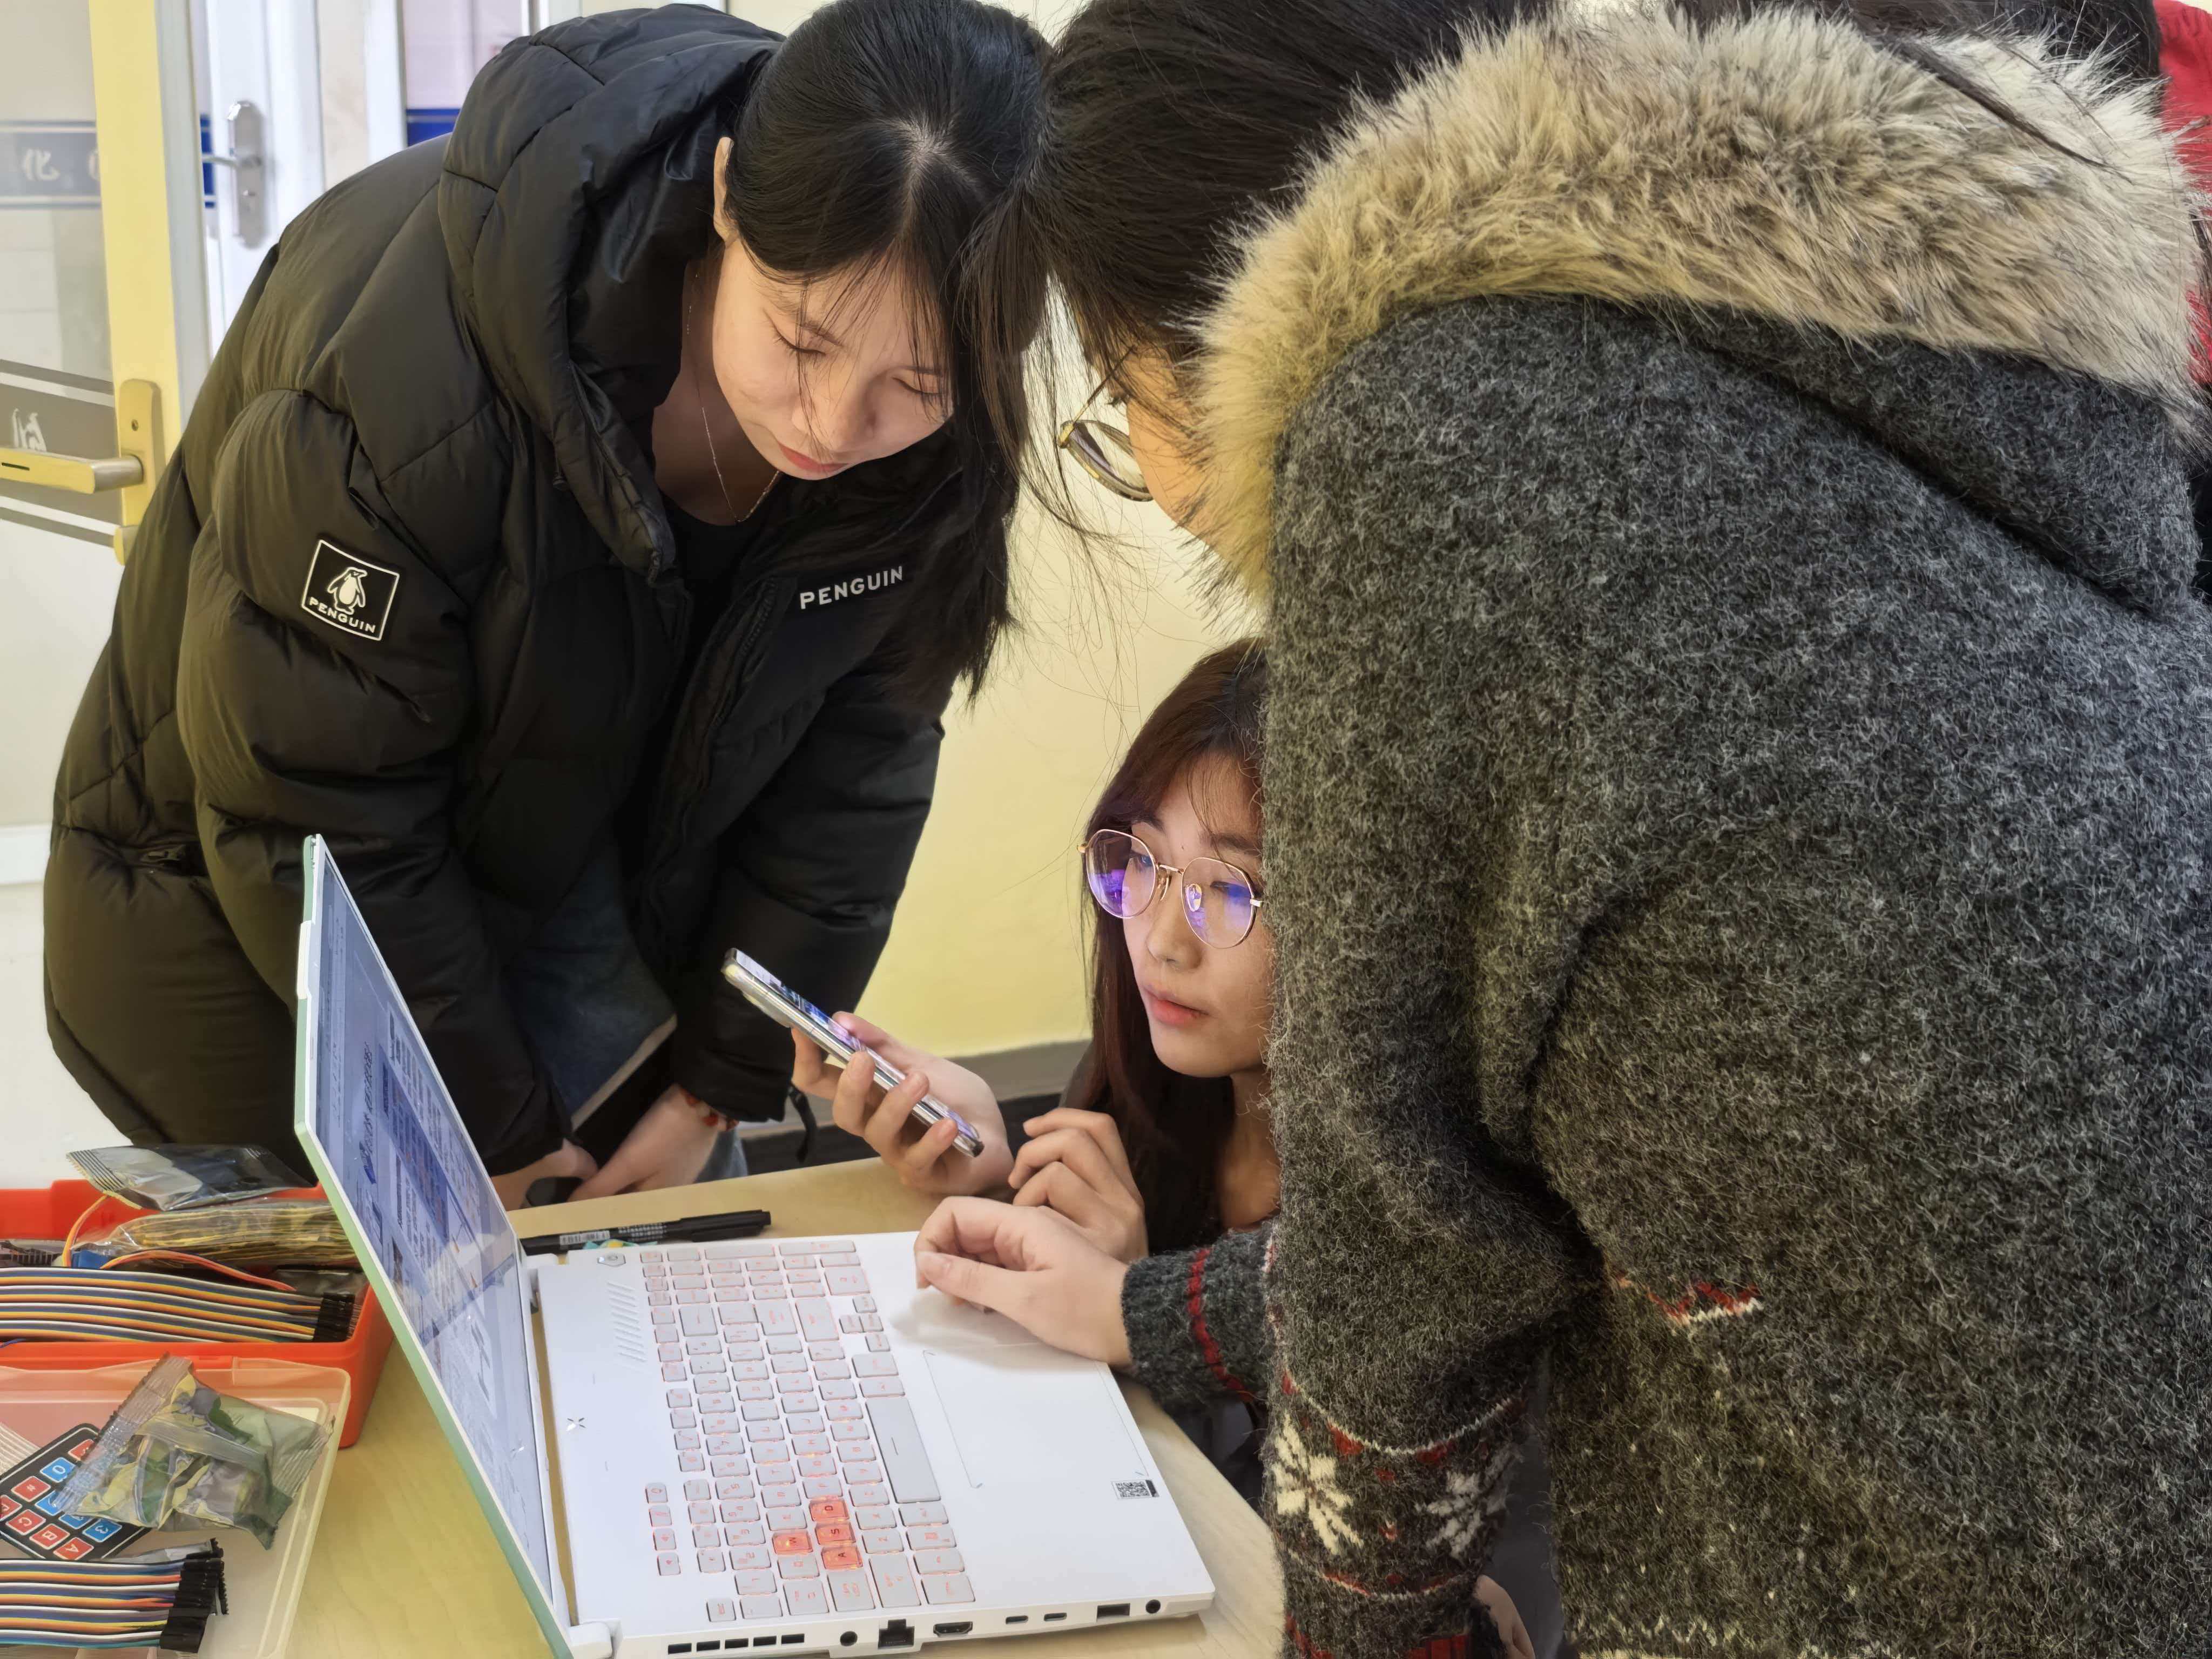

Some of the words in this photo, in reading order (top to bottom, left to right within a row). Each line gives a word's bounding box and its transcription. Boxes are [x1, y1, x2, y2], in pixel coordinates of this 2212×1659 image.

[799, 565, 903, 610] PENGUIN
[309, 596, 376, 633] PENGUIN
[18, 1516, 32, 1527] C
[95, 1525, 109, 1534] 3
[42, 1530, 58, 1541] B
[65, 1543, 79, 1553] A
